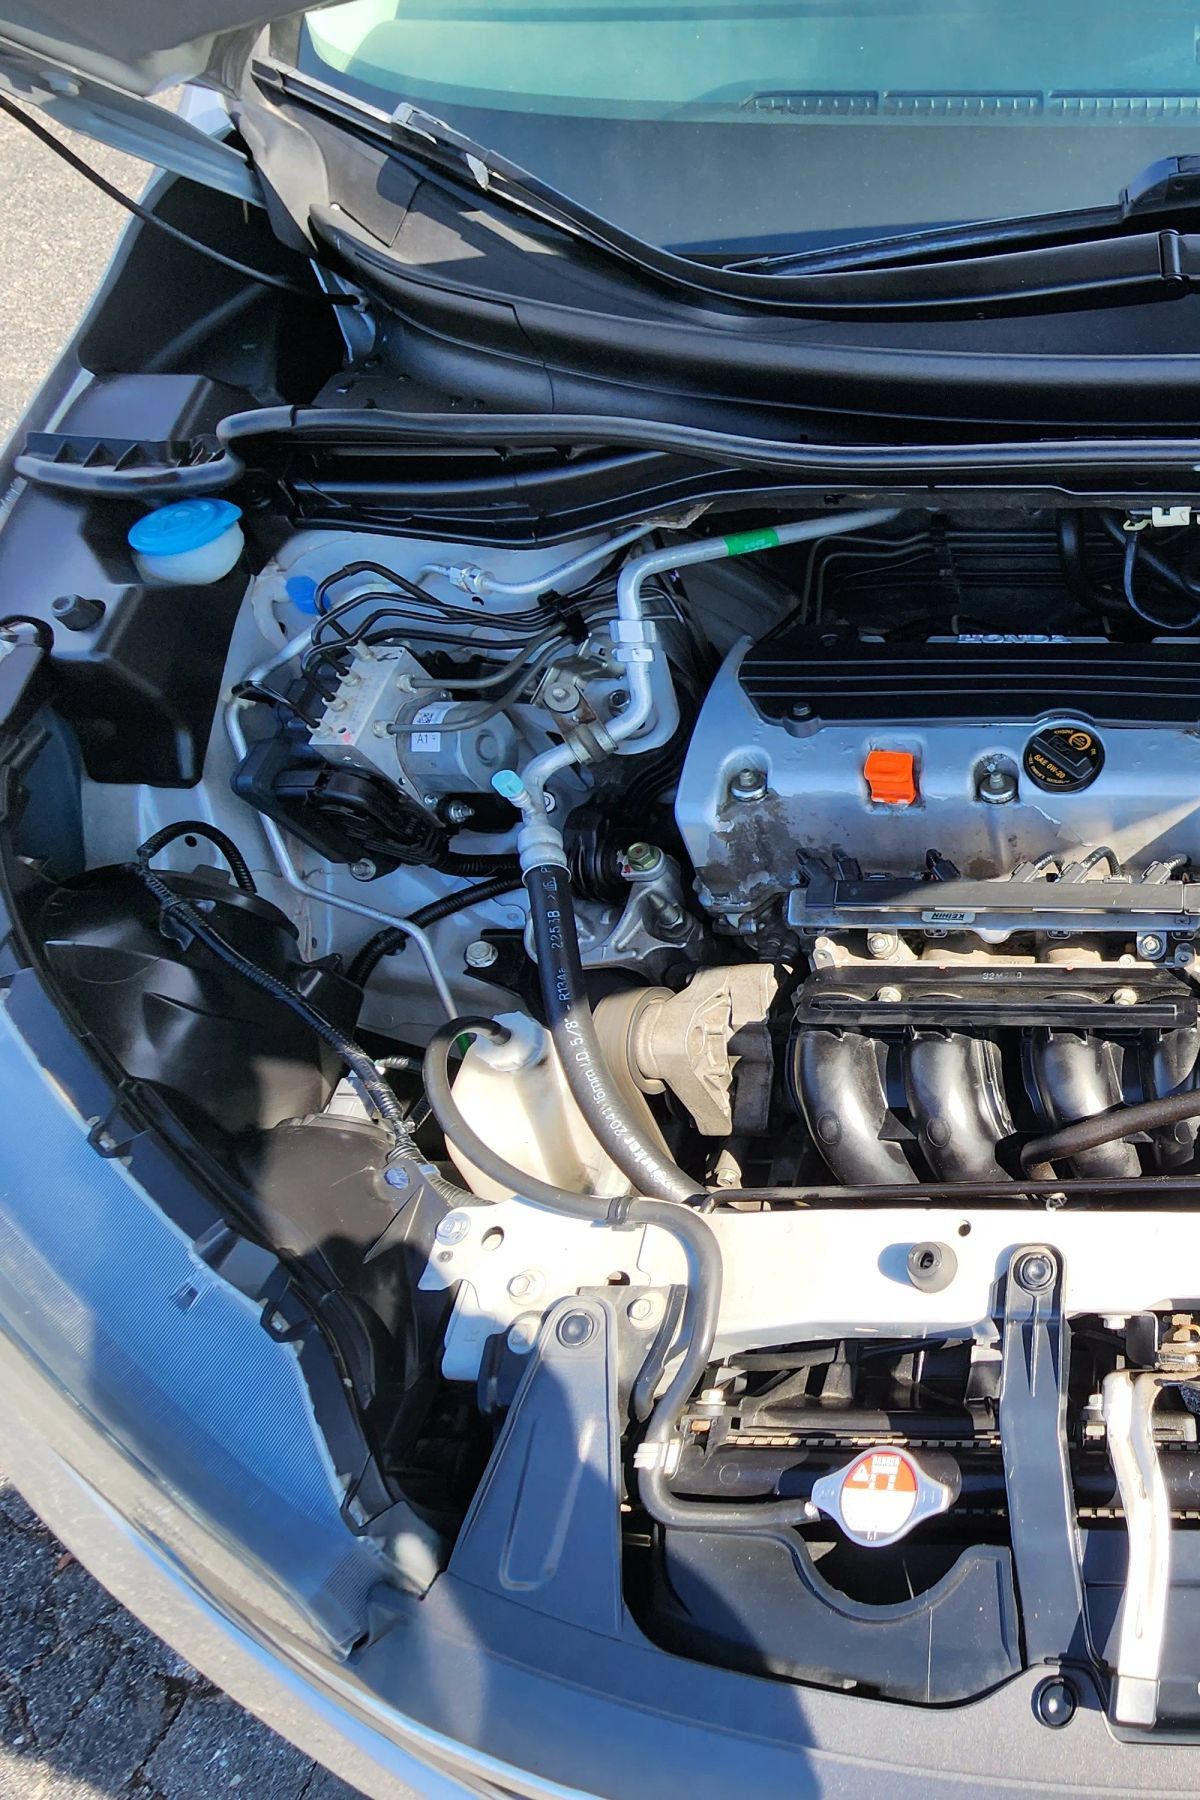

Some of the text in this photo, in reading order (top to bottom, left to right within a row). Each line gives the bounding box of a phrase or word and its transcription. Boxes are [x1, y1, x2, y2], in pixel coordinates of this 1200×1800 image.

[1033, 754, 1048, 767] SAE
[1046, 763, 1066, 779] 0W-20
[931, 911, 965, 921] KEIHIN
[585, 1068, 606, 1105] 16mm
